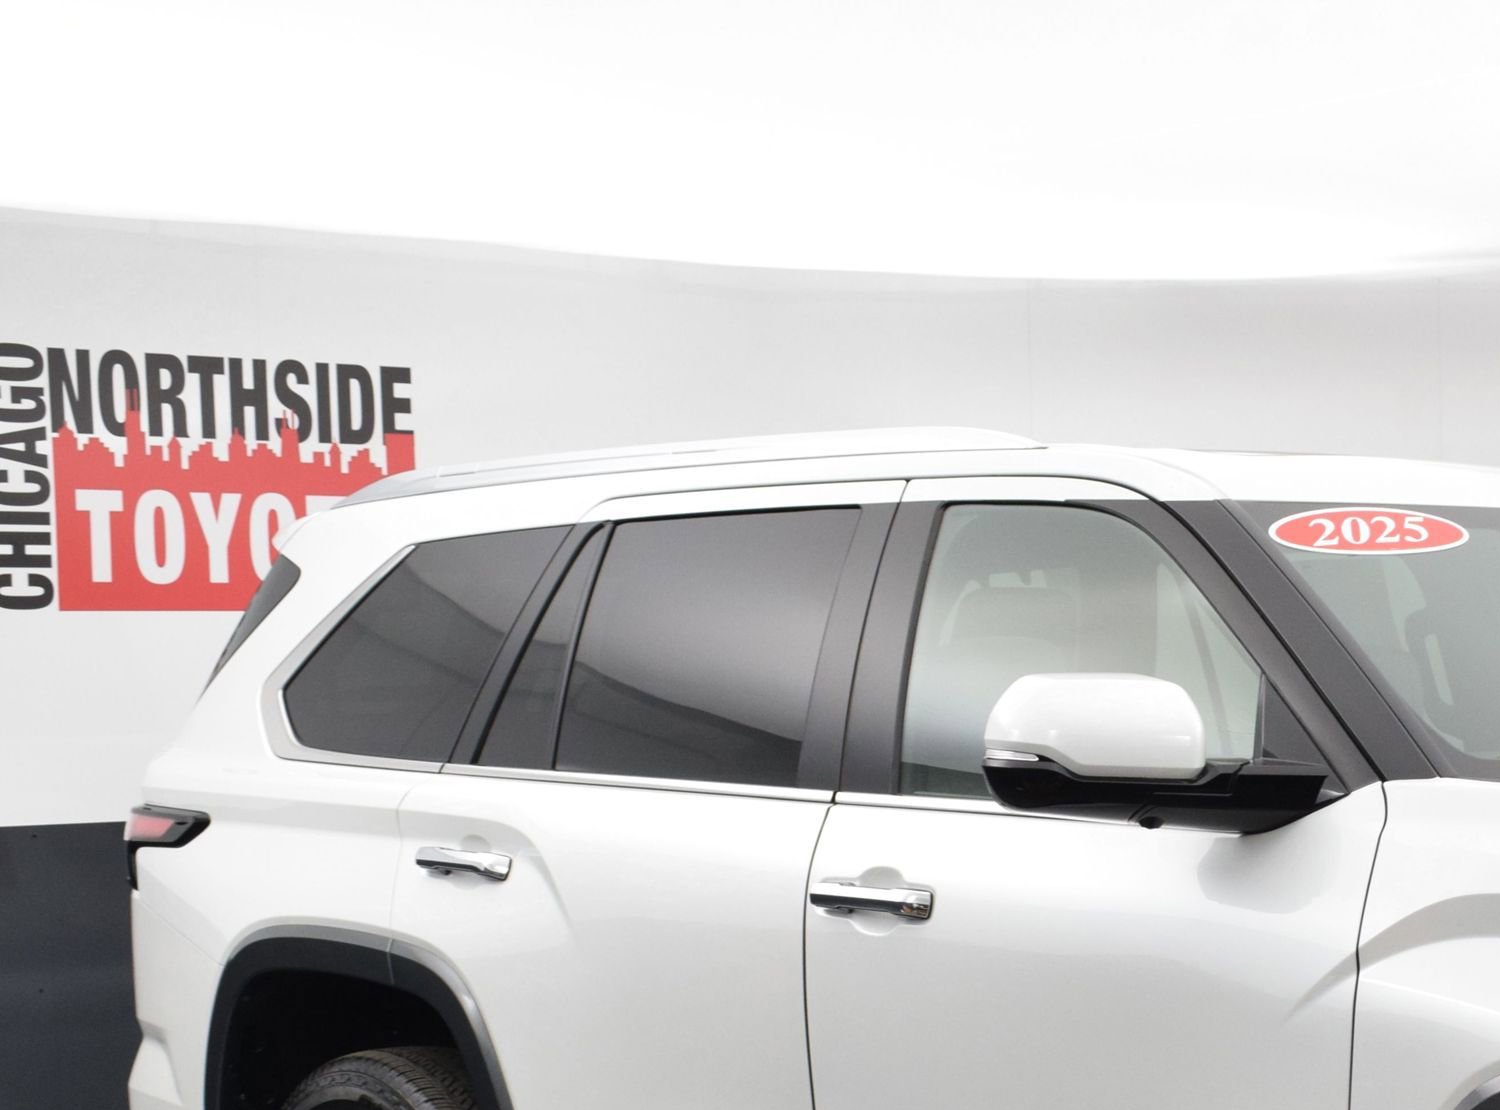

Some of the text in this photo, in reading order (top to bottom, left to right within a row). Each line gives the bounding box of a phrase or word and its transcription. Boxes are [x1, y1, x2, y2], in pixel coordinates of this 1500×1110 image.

[47, 347, 412, 445] NORTHSIDE
[0, 343, 54, 610] CHICAGO
[75, 489, 350, 584] TOYO
[1308, 515, 1429, 546] 2025
